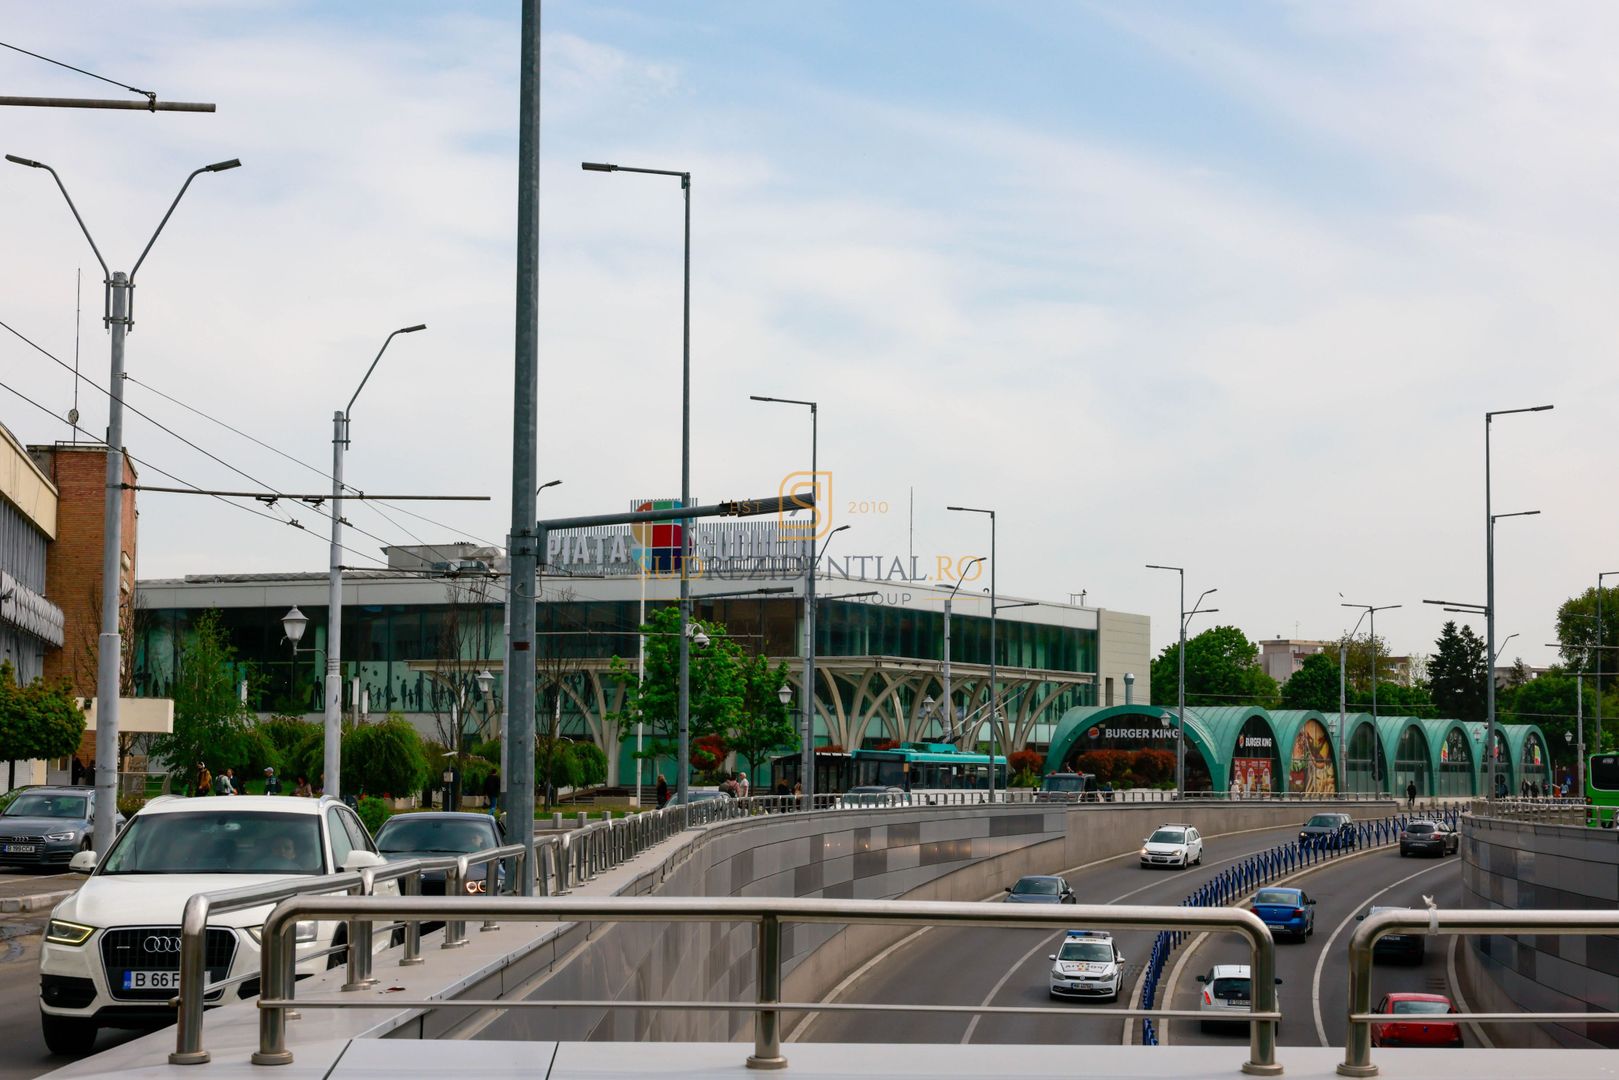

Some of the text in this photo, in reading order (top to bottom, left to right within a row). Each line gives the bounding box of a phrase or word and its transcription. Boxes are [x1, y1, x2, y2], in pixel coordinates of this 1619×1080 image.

[1105, 728, 1150, 739] BURGER
[1151, 728, 1180, 739] KING
[1245, 737, 1272, 747] BURGER KING
[135, 973, 146, 987] B
[151, 973, 169, 987] 66
